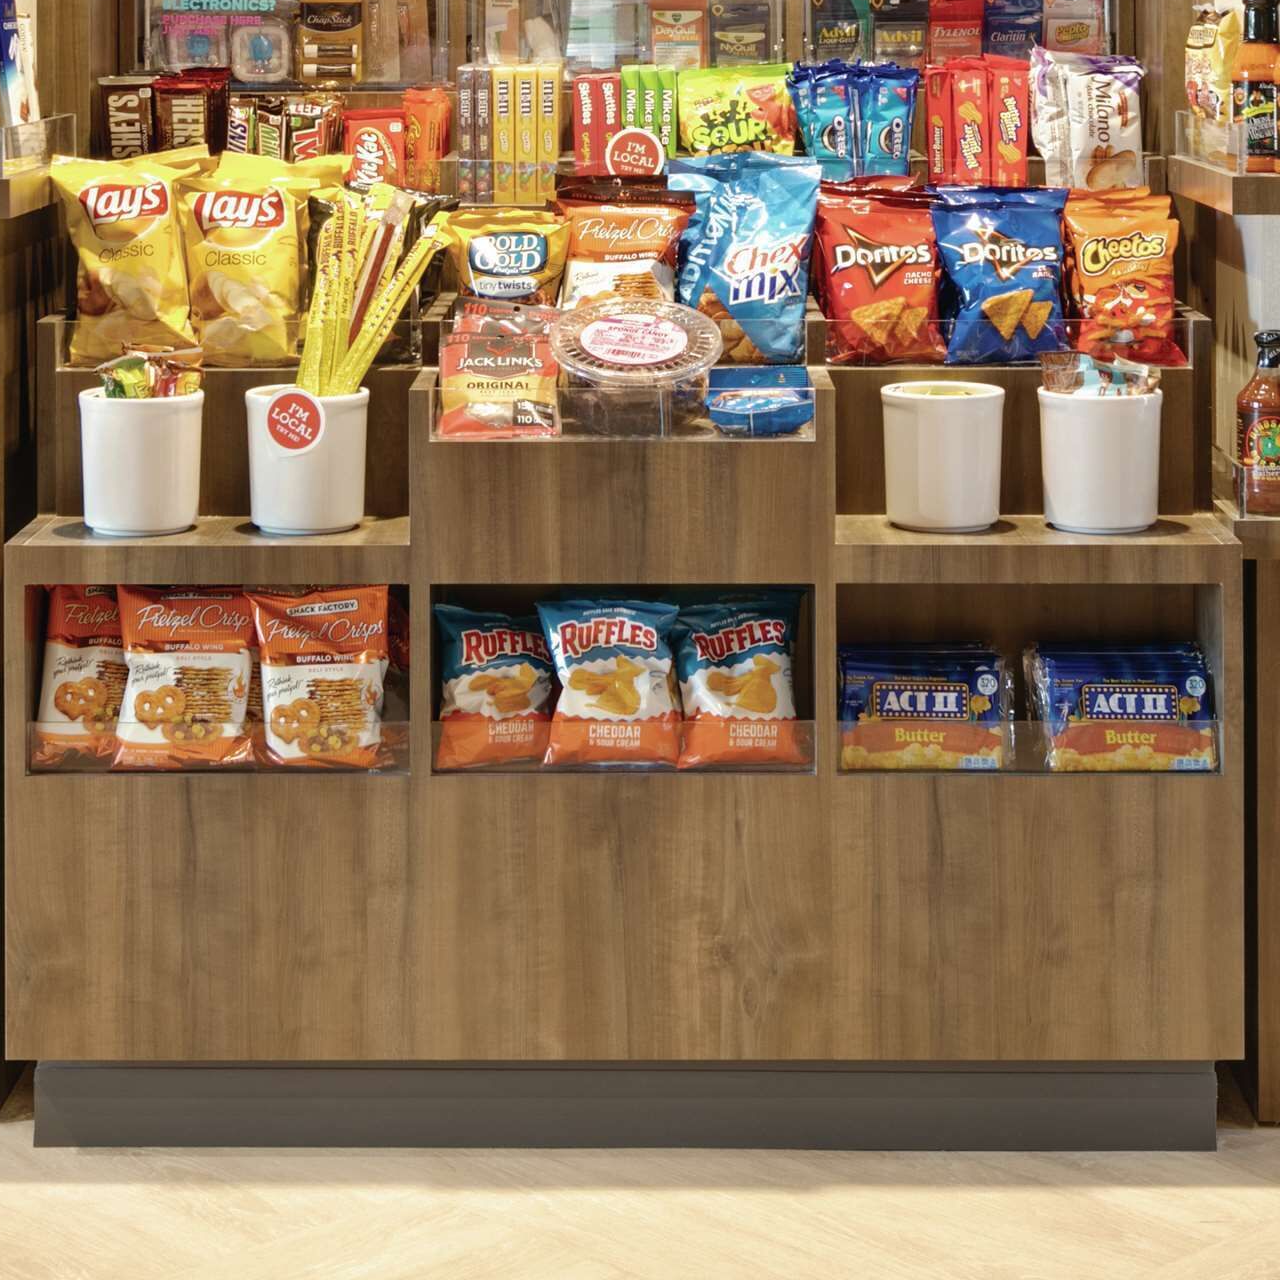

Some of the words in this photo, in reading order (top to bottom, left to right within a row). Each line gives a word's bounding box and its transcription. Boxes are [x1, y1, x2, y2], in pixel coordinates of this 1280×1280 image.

[656, 25, 696, 37] DayQuil
[820, 27, 856, 38] Advil
[879, 30, 922, 42] Advil
[934, 27, 981, 38] TYLENOL
[991, 32, 1026, 42] Claritin
[720, 44, 755, 54] NyQuil
[578, 82, 591, 125] Skittles
[601, 82, 616, 125] Skittles
[625, 89, 636, 122] Mike
[644, 90, 655, 123] Mike
[662, 89, 673, 122] Mike
[1091, 77, 1114, 143] Milano
[834, 115, 846, 158] OREO
[892, 117, 903, 160] OREO
[627, 142, 646, 154] I'M
[613, 151, 655, 168] LOCAL
[579, 217, 633, 249] Pretzel
[99, 243, 154, 264] Classic
[205, 250, 266, 267] Classic
[605, 253, 638, 261] BUFFALO
[726, 235, 807, 275] Chex
[832, 244, 932, 270] Doritos
[961, 242, 1058, 265] Doritos
[1082, 231, 1165, 273] Cheetos
[479, 281, 497, 294] tiny
[498, 280, 532, 291] twists
[731, 267, 800, 303] mix
[457, 357, 495, 369] JACK
[288, 402, 309, 422] I'M
[271, 407, 312, 440] LOCAL
[289, 604, 316, 616] SNACK
[318, 601, 356, 613] FACTORY
[136, 604, 201, 637] Pretzel
[266, 619, 328, 649] Pretzel
[328, 618, 384, 644] Crisps
[558, 618, 657, 657] RUFFLES
[692, 619, 786, 662] RUFFLES
[165, 643, 201, 652] BUFFALO
[202, 643, 224, 651] WING
[462, 629, 554, 665] RUFFLES
[297, 655, 331, 663] BUFFALO
[883, 691, 928, 712] ACT
[932, 691, 959, 712] II
[1093, 693, 1138, 714] ACT
[1142, 694, 1168, 714] II
[489, 721, 534, 735] CHEDDAR
[589, 724, 641, 738] CHEDDAR
[730, 724, 778, 737] CHEDDAR
[895, 727, 947, 743] Butter
[1105, 729, 1158, 744] Butter
[616, 738, 641, 748] CREAM
